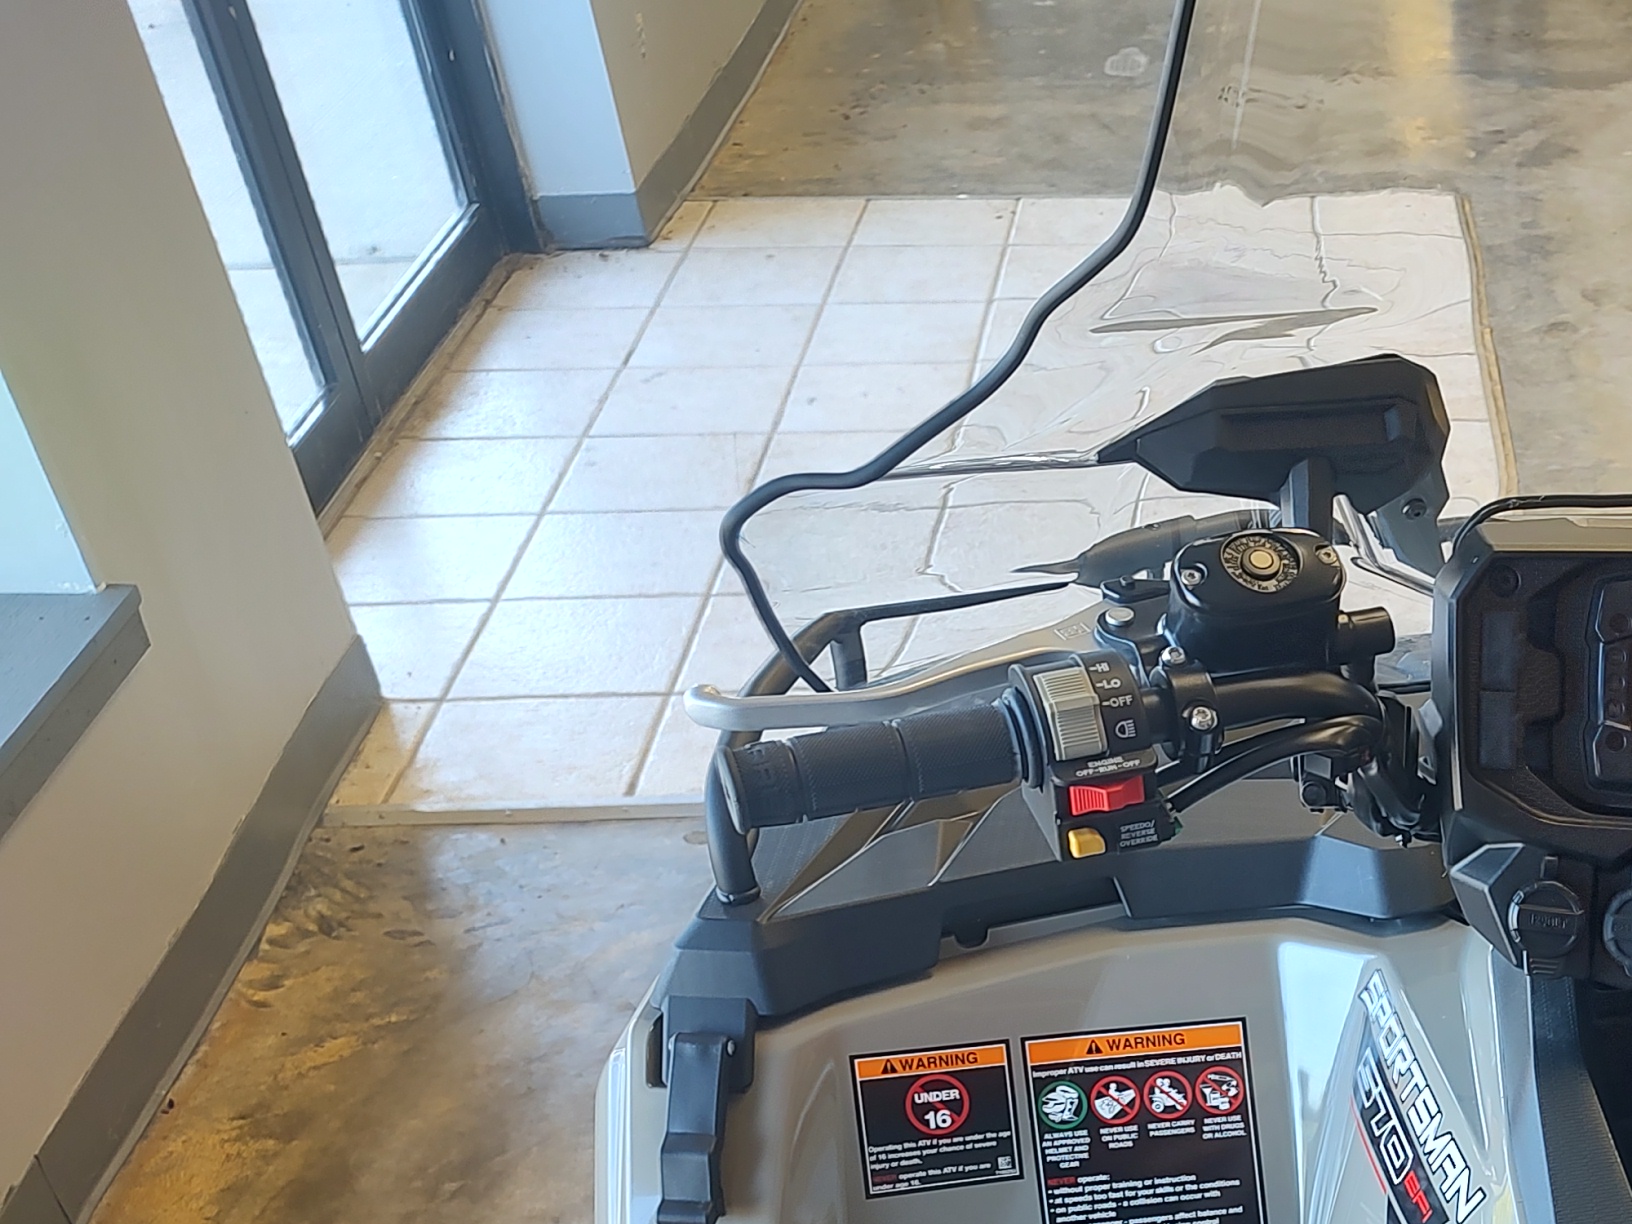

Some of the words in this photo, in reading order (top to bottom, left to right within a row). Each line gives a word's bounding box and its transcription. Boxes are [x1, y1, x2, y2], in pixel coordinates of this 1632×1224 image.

[1097, 662, 1110, 673] HI
[1104, 678, 1121, 688] LO
[1109, 695, 1133, 707] OFF
[1087, 756, 1124, 768] ENGINE
[1121, 828, 1155, 839] REVERSE
[1120, 836, 1158, 848] OVERRIDE
[1105, 1033, 1186, 1051] WARNING
[899, 1052, 978, 1071] WARNING
[1032, 1069, 1067, 1078] Improper
[1068, 1066, 1084, 1074] ATV
[1143, 1057, 1176, 1067] SEVERE
[1177, 1055, 1206, 1064] INJURY
[1214, 1052, 1242, 1060] DEATH
[914, 1089, 960, 1103] UNDER
[924, 1109, 952, 1129] 16
[868, 1144, 902, 1153] Operating
[888, 1150, 921, 1159] increases
[922, 1148, 938, 1156] your
[900, 1158, 923, 1166] death.
[872, 1174, 897, 1183] NEVER
[899, 1171, 927, 1180] operate
[943, 1166, 957, 1174] ATV
[1403, 1170, 1433, 1224] EFI
